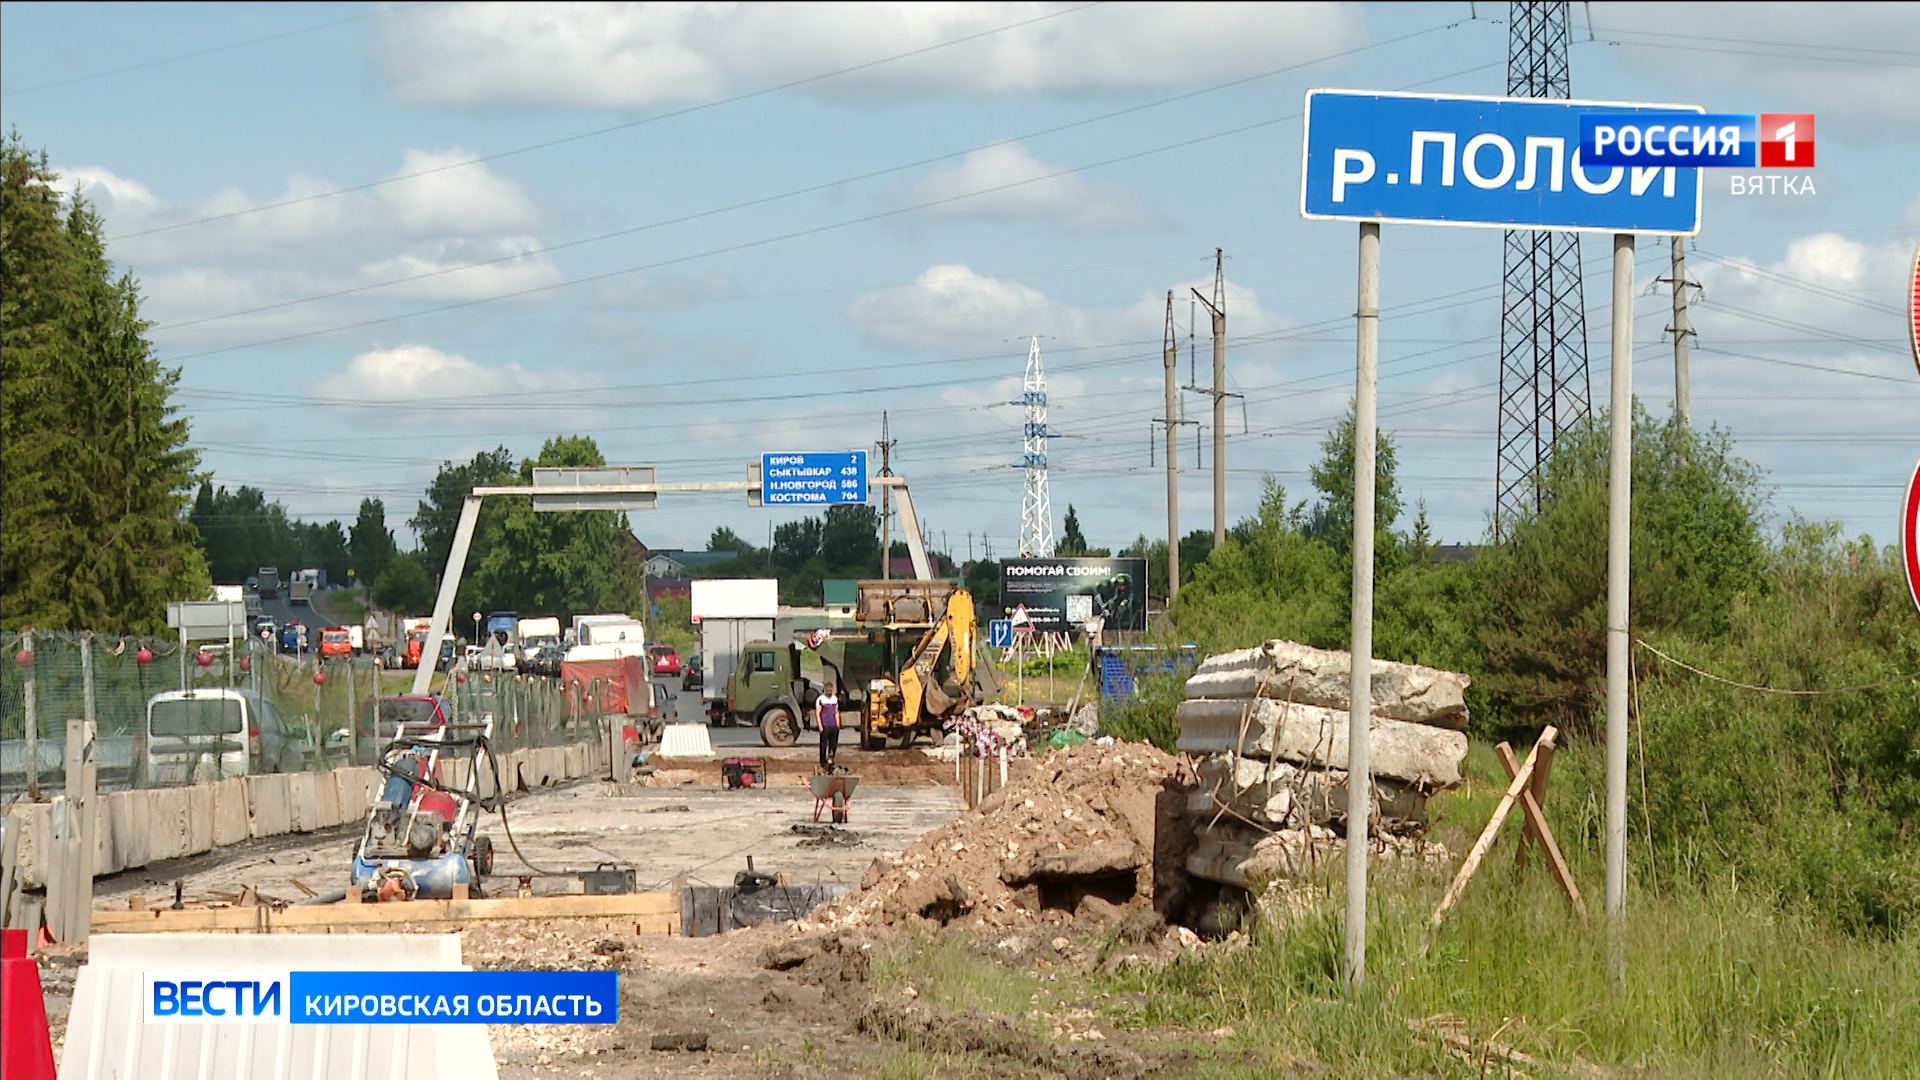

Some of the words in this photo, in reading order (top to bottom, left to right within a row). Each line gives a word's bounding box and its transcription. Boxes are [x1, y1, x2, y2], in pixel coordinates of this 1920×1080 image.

[769, 455, 804, 465] КИРОВ
[851, 455, 857, 464] 2
[769, 467, 832, 477] СЫКТЫВКАР
[840, 467, 857, 476] 438
[770, 493, 827, 502] КОСТРОМА
[1006, 565, 1064, 576] ПОМОГАЙ
[1066, 566, 1111, 576] СВОИМ!
